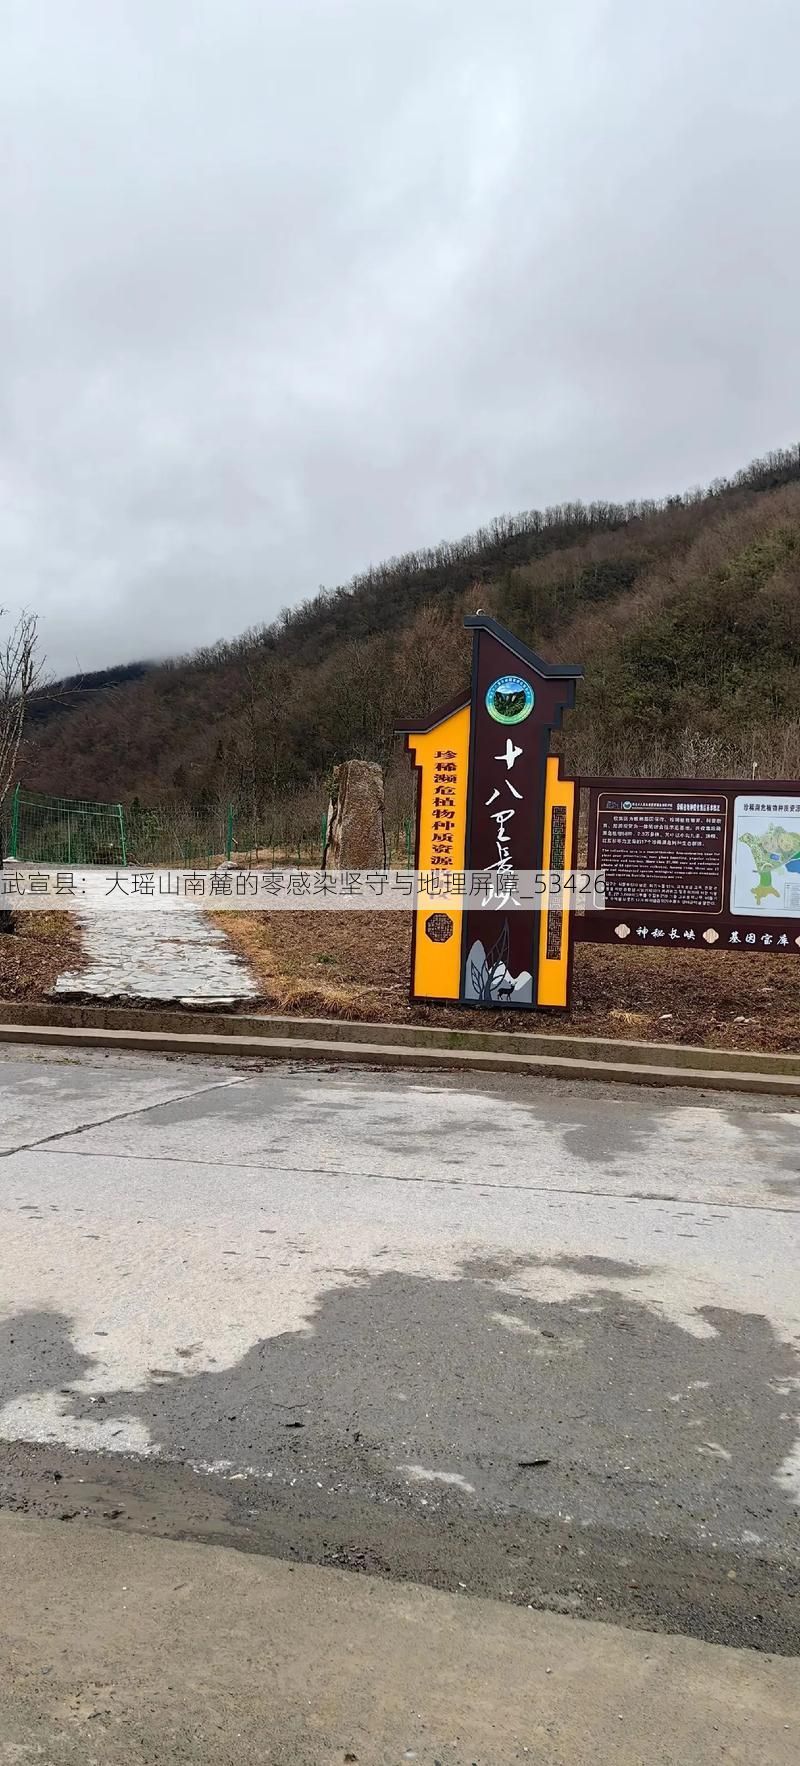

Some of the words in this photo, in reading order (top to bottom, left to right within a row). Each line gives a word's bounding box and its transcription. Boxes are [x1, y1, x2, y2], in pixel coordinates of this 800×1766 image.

[635, 926, 696, 941] 神秘长峡
[728, 930, 790, 947] 基因宝库
